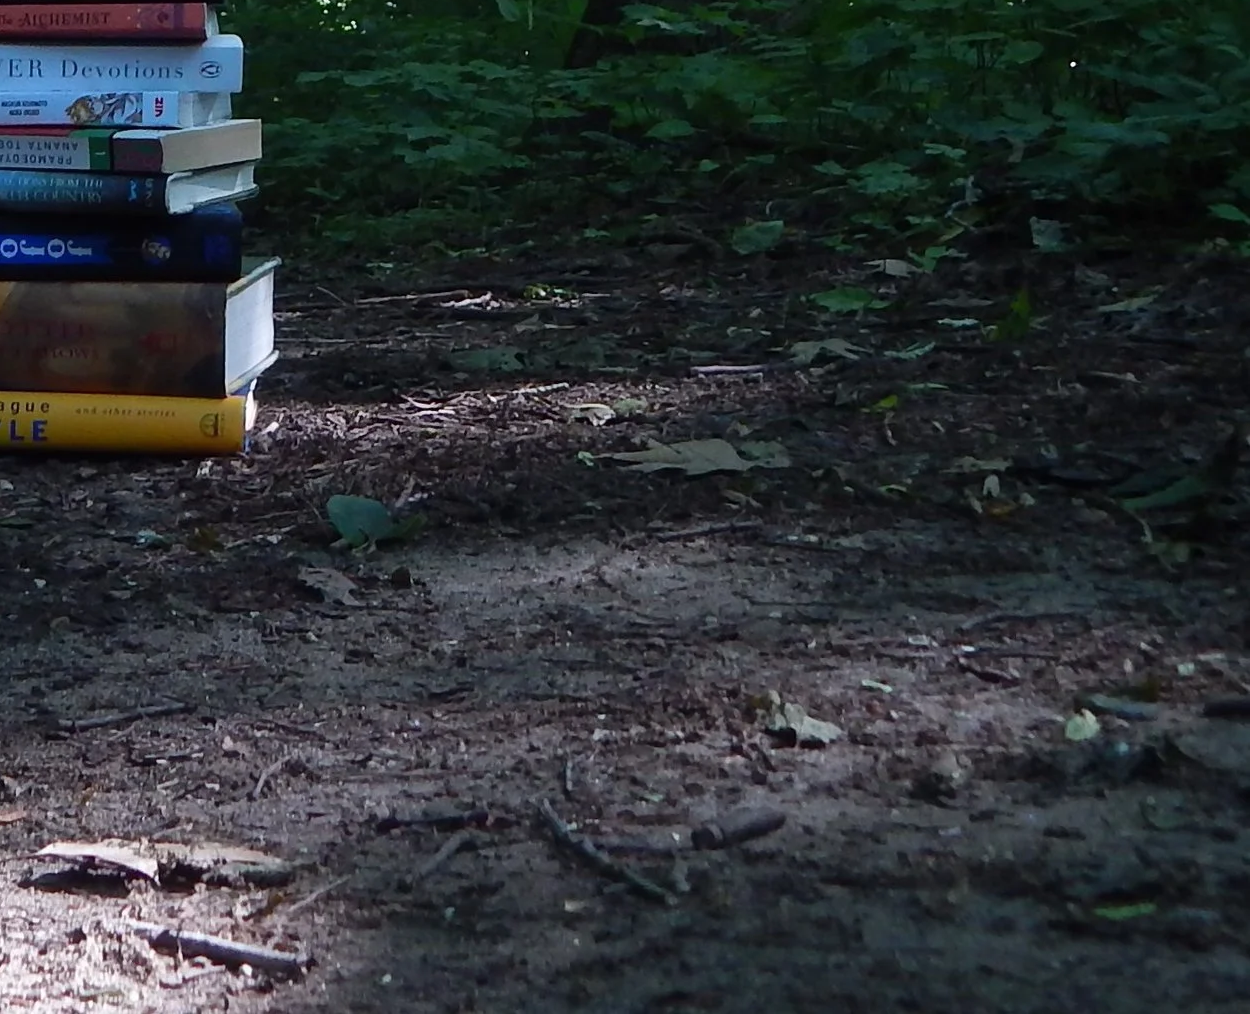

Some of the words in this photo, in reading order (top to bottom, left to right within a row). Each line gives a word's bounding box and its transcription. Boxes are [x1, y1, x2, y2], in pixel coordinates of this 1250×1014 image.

[18, 12, 111, 29] ALCHEMIST
[62, 58, 184, 79] Devotions
[28, 140, 79, 151] ANANTA
